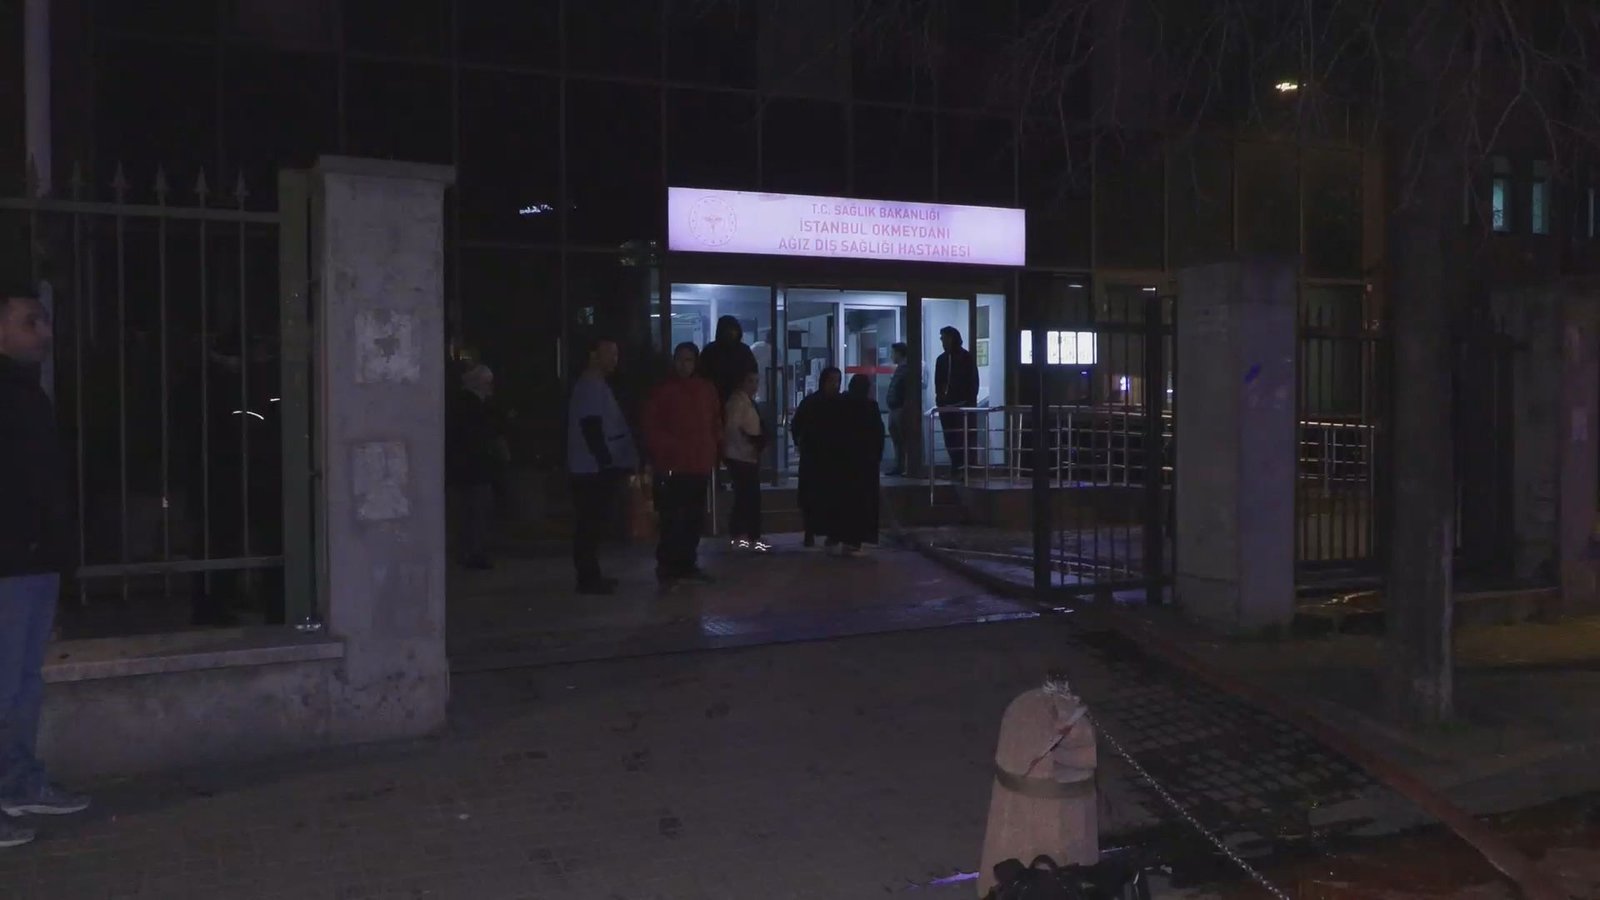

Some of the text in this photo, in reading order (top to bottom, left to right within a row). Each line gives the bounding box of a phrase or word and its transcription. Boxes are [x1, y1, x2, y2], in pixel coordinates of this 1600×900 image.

[834, 203, 876, 217] SAĞLIK
[879, 207, 940, 221] BAKANLIĞI
[800, 217, 950, 239] İSTANBUL OKMEYDANI
[778, 235, 811, 250] AĞIZ
[841, 239, 894, 254] SAĞLIĞI
